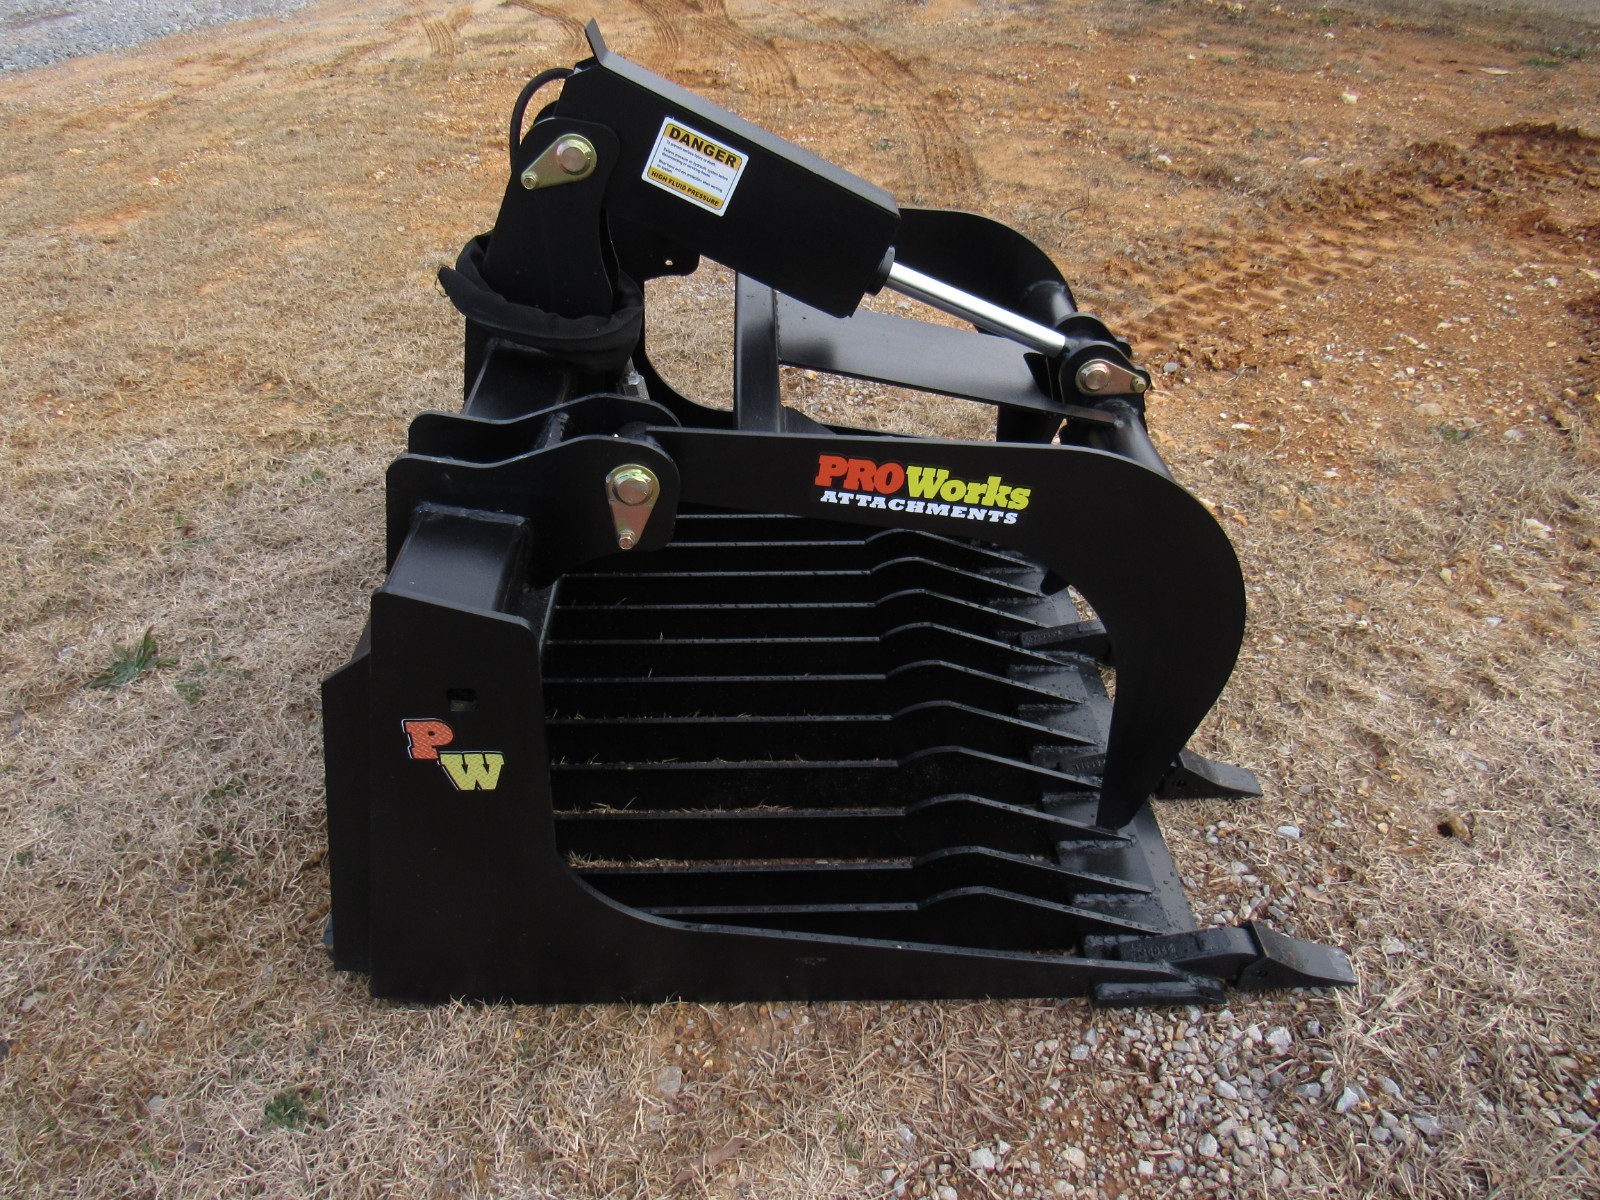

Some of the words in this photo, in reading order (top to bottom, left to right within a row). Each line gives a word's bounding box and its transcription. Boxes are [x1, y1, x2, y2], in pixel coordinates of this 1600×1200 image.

[669, 127, 737, 168] DANGER
[651, 171, 668, 182] HIGH
[668, 178, 686, 190] FLUID
[687, 188, 719, 206] PRESSURE
[820, 490, 1018, 525] ATTACHMENTS
